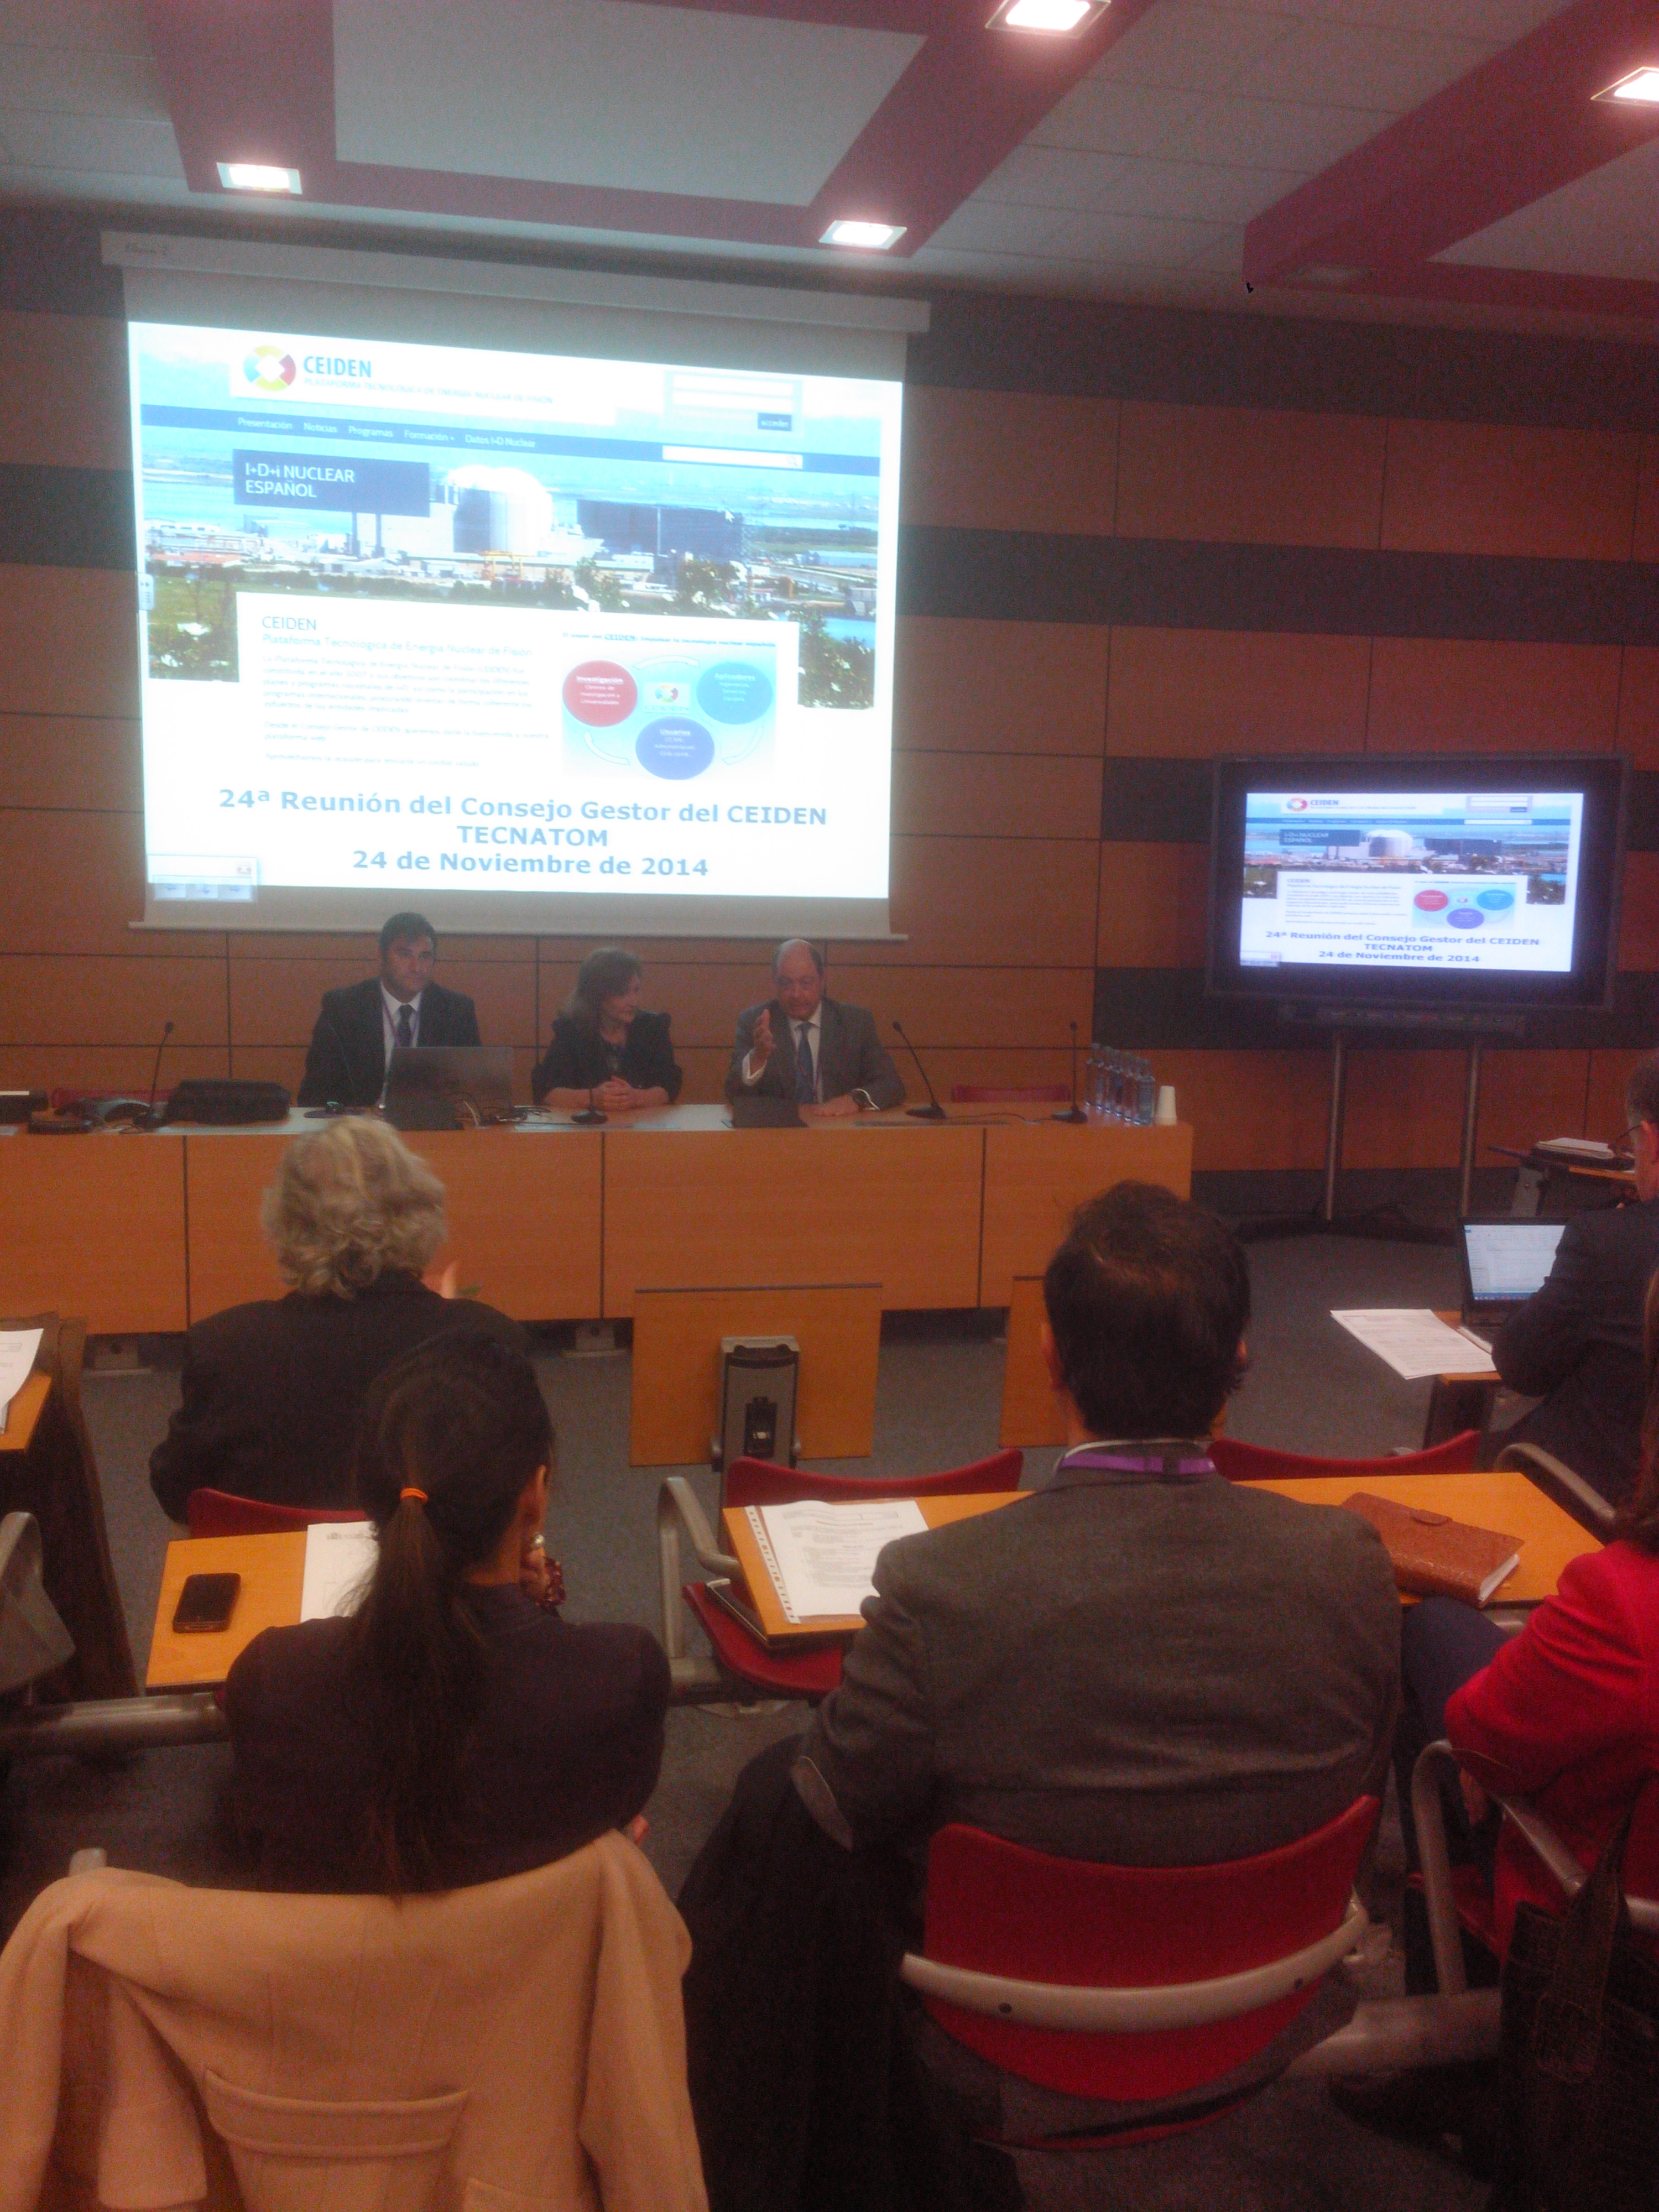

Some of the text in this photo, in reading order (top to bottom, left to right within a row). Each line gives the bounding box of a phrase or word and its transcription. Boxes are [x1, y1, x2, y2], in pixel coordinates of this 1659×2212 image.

[302, 355, 372, 378] CEIDEN
[303, 421, 337, 434] Noticias
[348, 425, 393, 440] Programas
[404, 430, 449, 442] Formación
[465, 434, 489, 444] Datos
[505, 437, 535, 447] Nuclear
[245, 463, 355, 483] I+D+i NUCLEAR
[245, 479, 317, 498] ESPAÑOL
[262, 615, 317, 631] CEIDEN
[263, 634, 321, 646] Plataforma
[447, 644, 484, 654] Nuclear
[220, 789, 826, 825] 24ª Reunión del Consejo Gestor del CEIDEN
[457, 826, 608, 847] TECNATOM
[353, 851, 708, 876] 24 de Noviembre de 2014
[1366, 935, 1417, 943] Consejo
